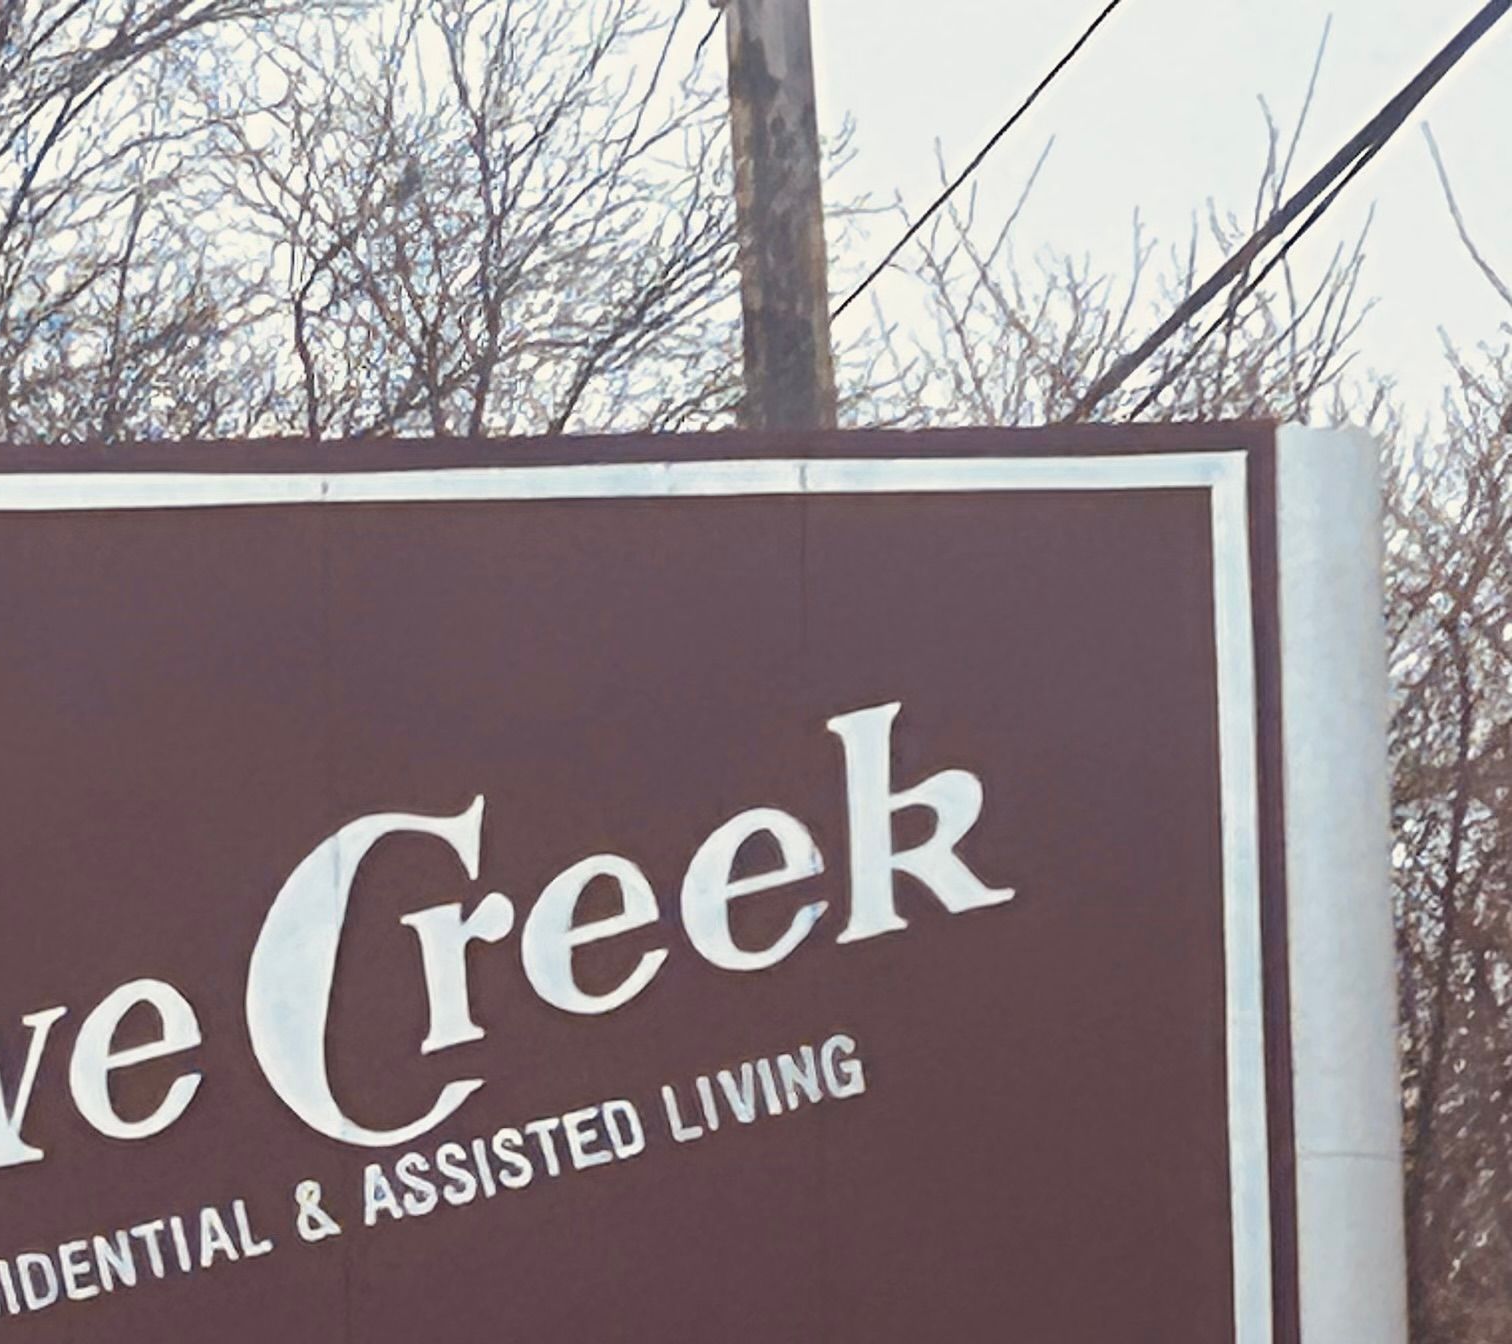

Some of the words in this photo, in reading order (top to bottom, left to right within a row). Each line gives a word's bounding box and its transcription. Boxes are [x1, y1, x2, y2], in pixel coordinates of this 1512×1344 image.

[244, 699, 1018, 1149] Creek
[294, 1178, 343, 1243] &
[362, 1098, 646, 1227] ASSISTED
[660, 1033, 866, 1144] LIVING
